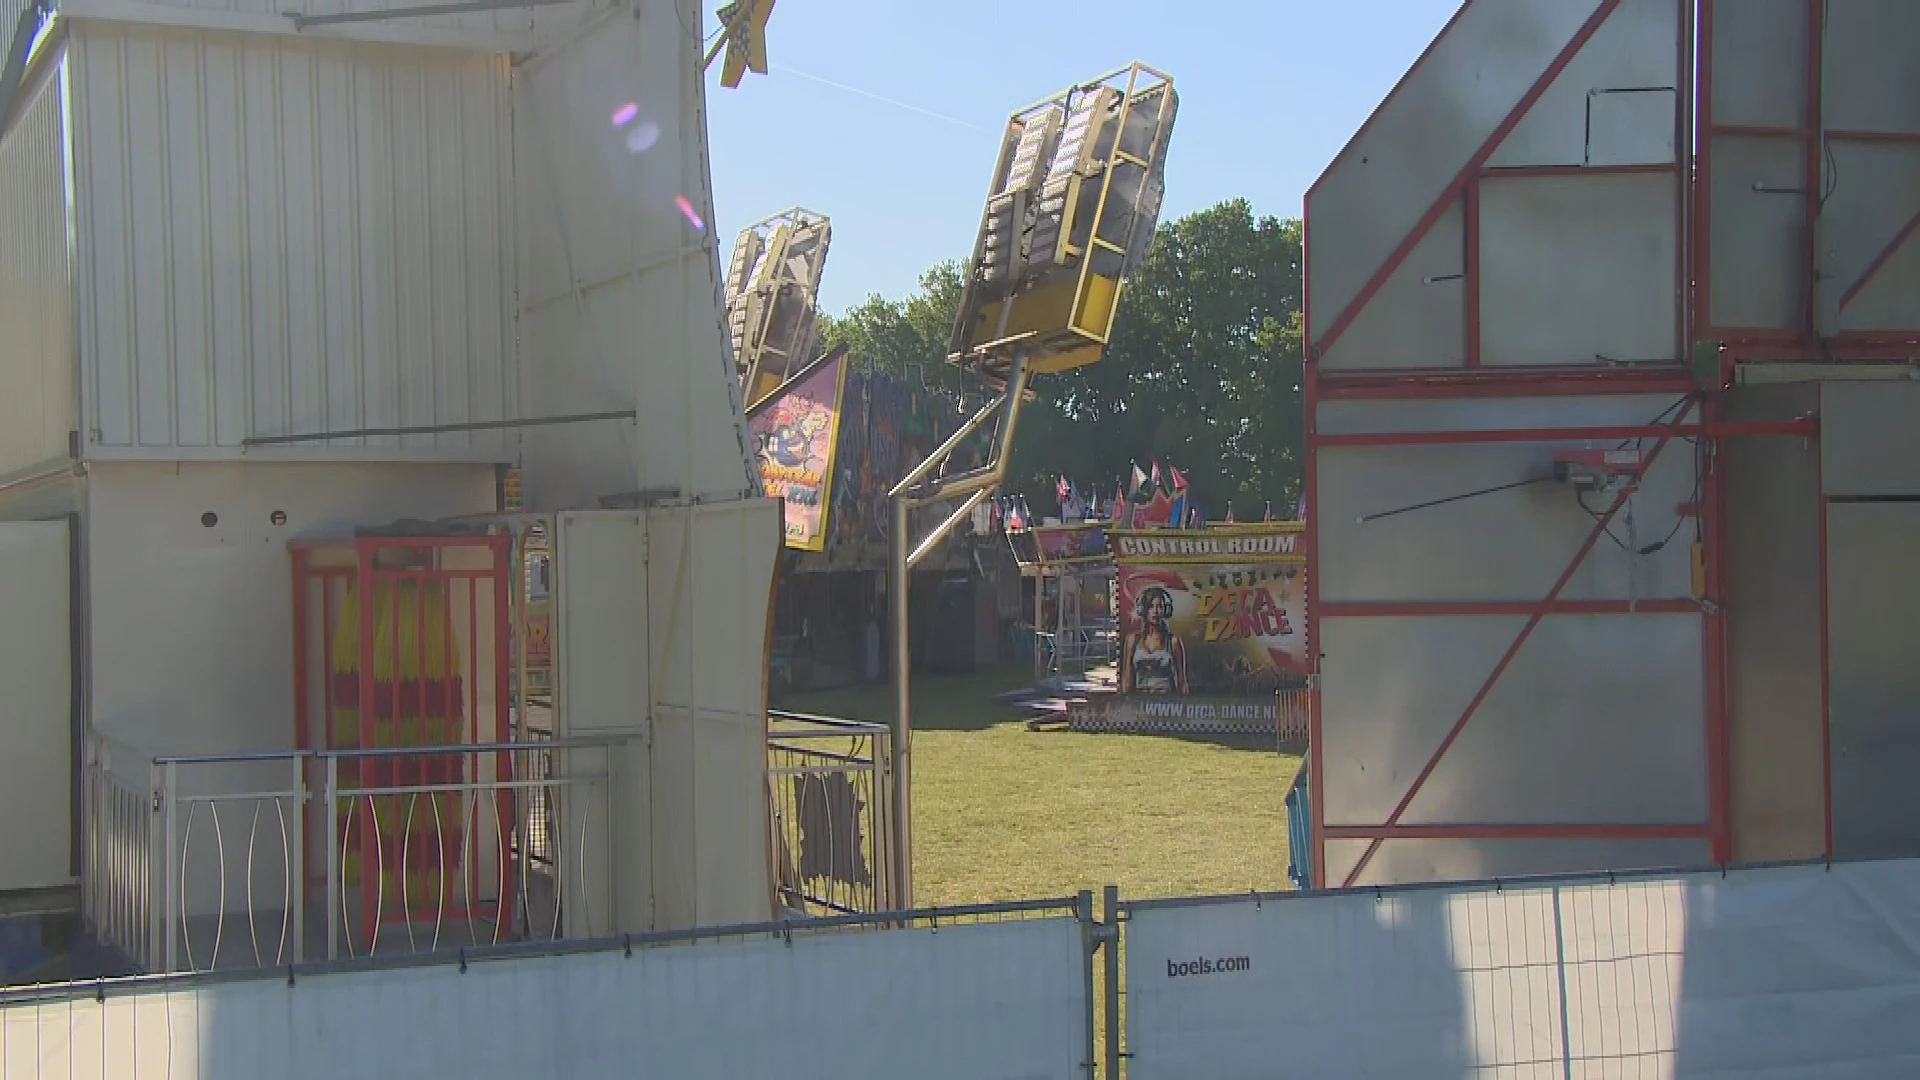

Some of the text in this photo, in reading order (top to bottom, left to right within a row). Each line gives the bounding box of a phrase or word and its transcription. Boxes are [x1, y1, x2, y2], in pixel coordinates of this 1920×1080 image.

[1119, 534, 1297, 555] CONTROL ROOM
[1194, 587, 1277, 618] DECA
[1204, 607, 1293, 642] DANCE
[1167, 955, 1250, 978] boels.com
